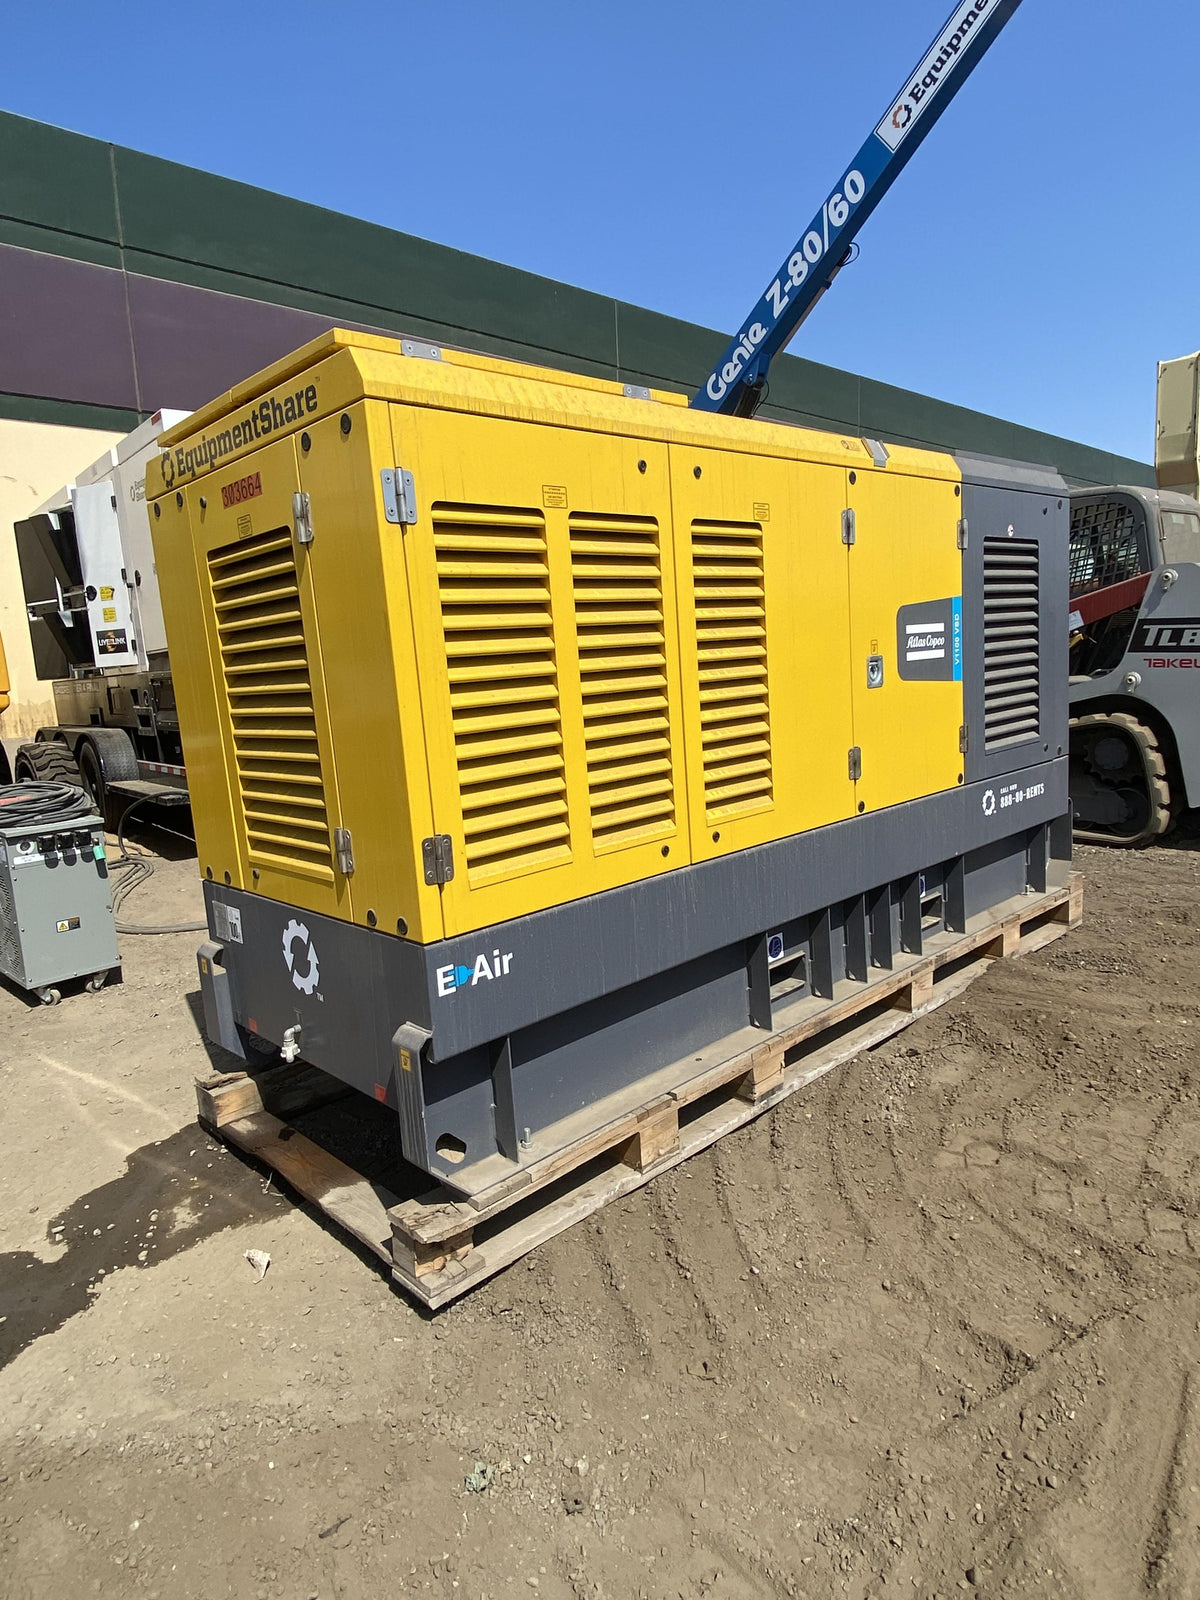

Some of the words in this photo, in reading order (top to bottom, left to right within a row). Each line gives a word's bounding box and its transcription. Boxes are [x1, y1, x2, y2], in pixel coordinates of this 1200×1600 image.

[706, 322, 768, 401] Genie
[765, 169, 866, 319] Z-80/60
[175, 384, 318, 478] EquipmentShare
[906, 635, 927, 649] Atlas
[926, 634, 945, 649] Copco
